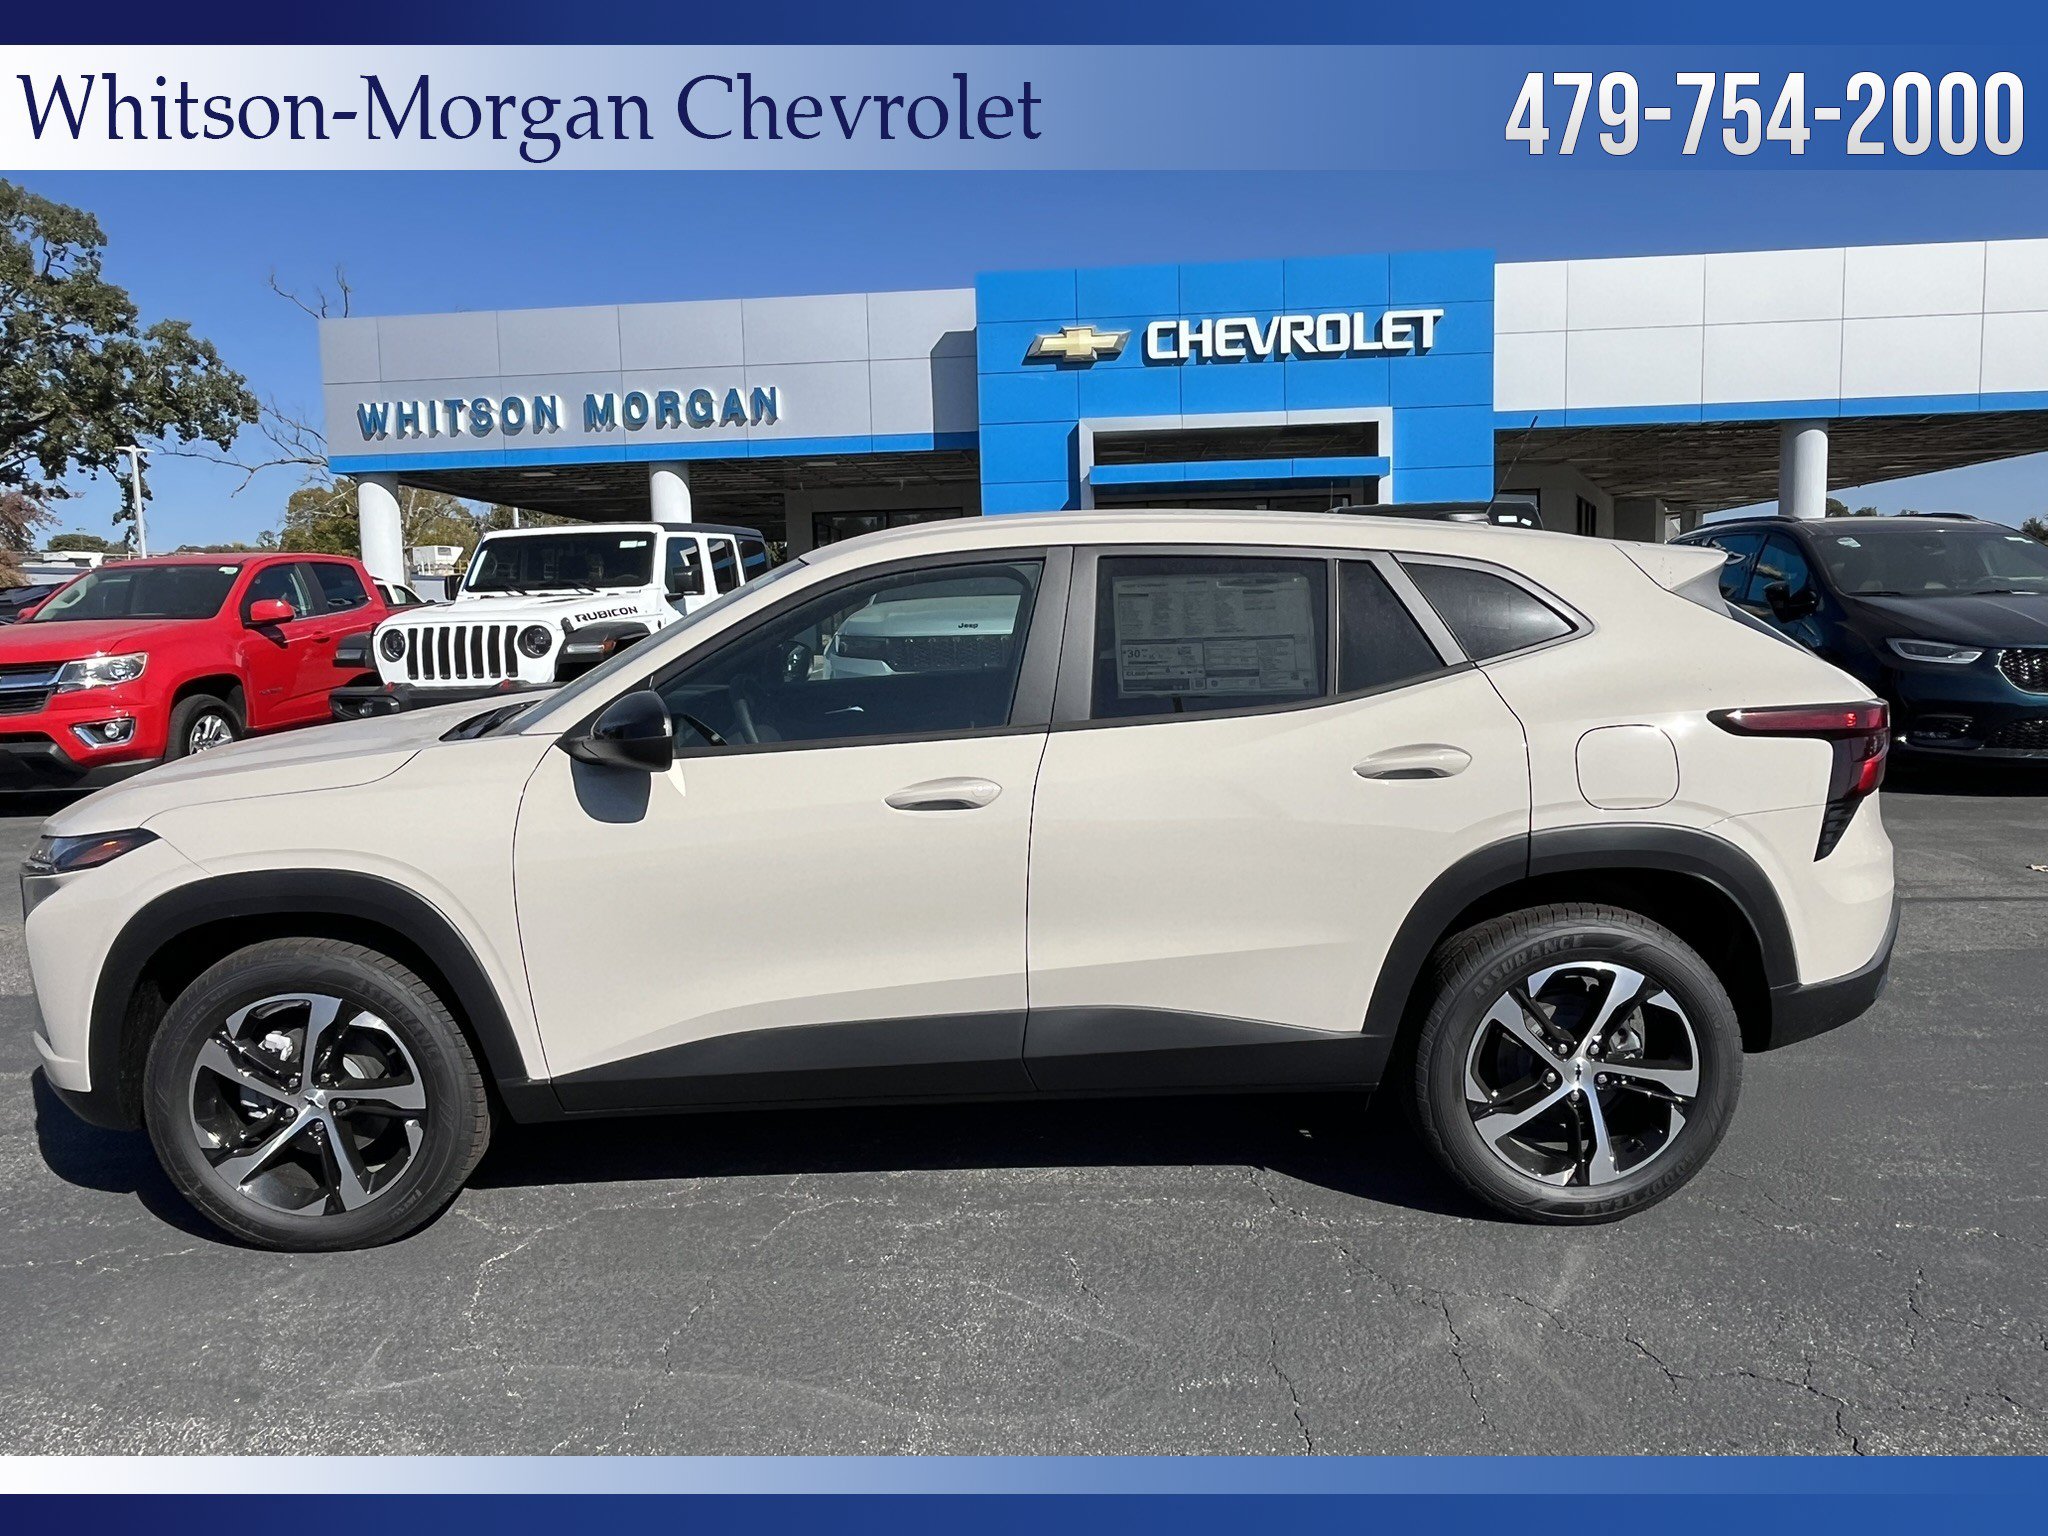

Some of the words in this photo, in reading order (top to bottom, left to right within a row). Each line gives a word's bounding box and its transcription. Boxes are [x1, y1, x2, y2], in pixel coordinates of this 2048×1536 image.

[1145, 308, 1445, 362] CHEVROLET
[357, 395, 562, 441] WHITSON
[584, 386, 780, 433] MORGAN
[574, 606, 639, 623] RUBICON
[957, 622, 979, 630] Jeep
[1473, 934, 1585, 999] ASSURANCE
